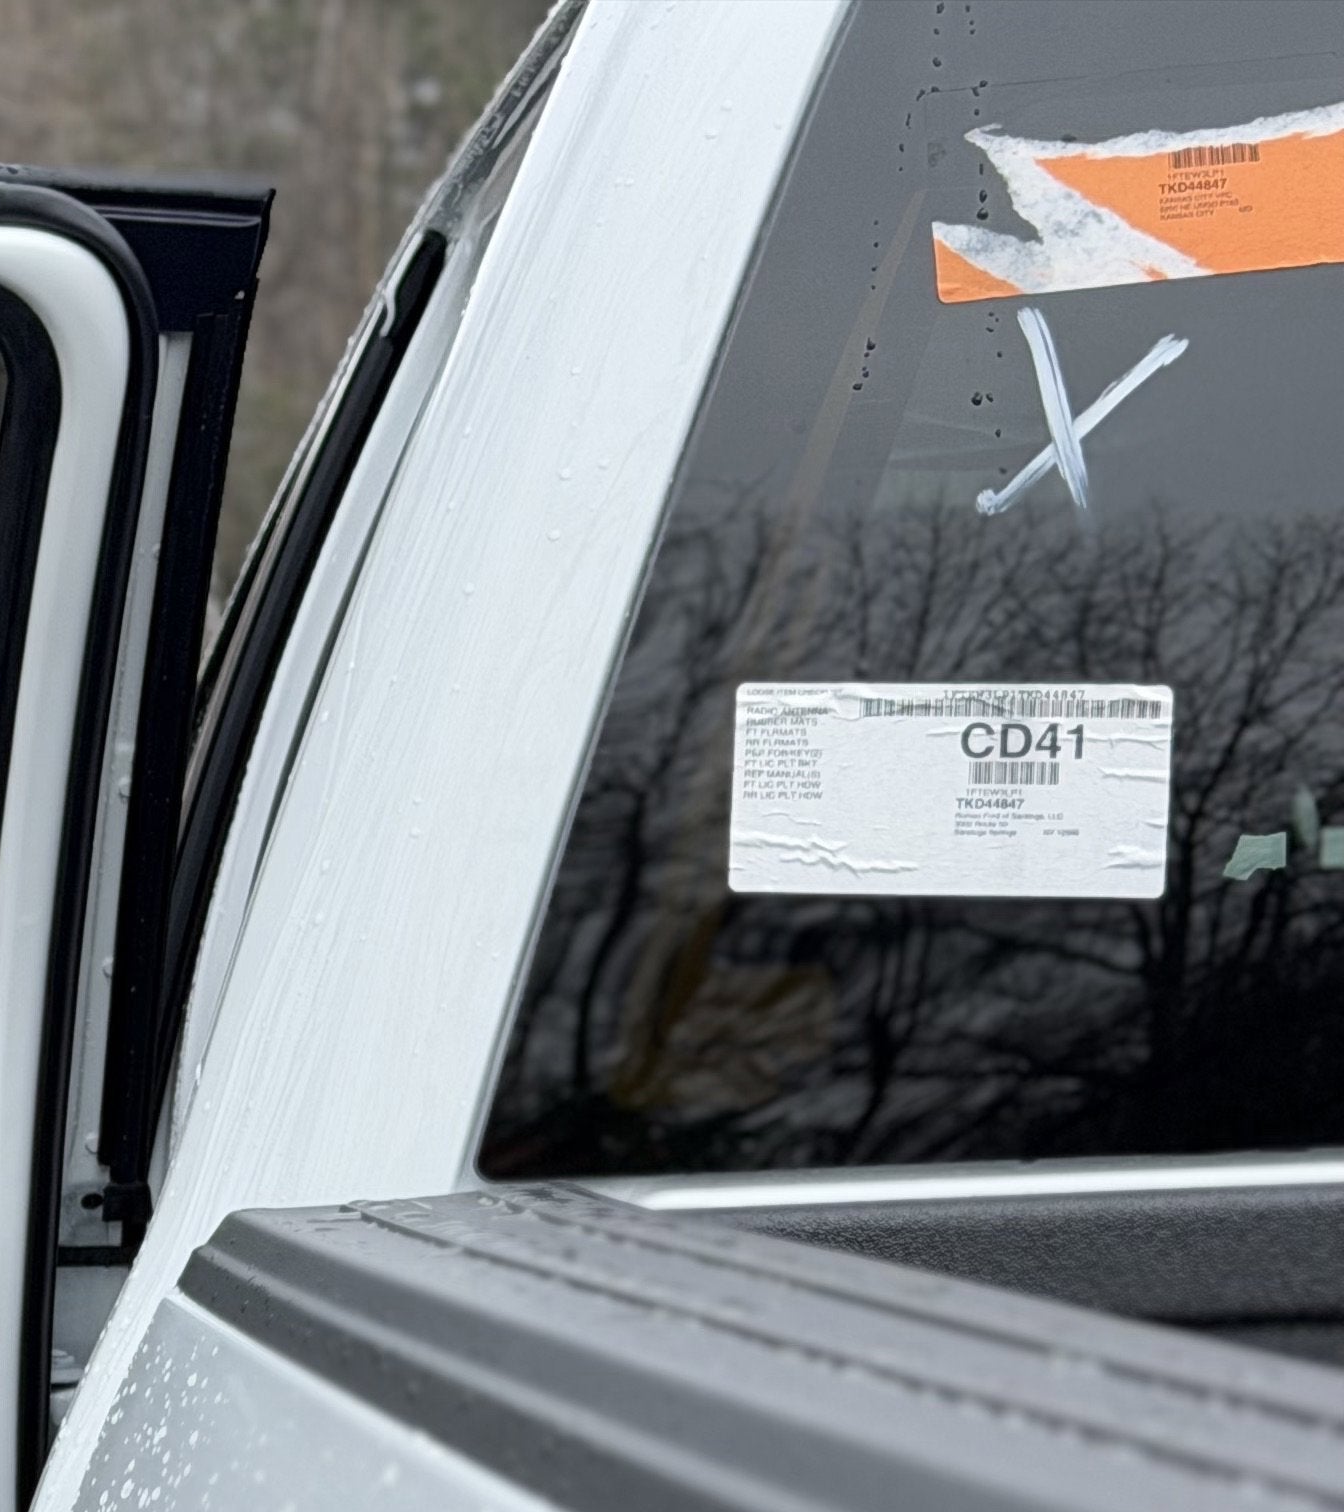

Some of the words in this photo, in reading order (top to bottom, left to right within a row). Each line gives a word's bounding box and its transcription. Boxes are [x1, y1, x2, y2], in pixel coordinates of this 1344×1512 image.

[1158, 178, 1227, 194] TKD44847
[746, 706, 778, 714] RADIO
[790, 717, 818, 726] MATS
[960, 722, 1085, 760] CD41
[955, 798, 1026, 810] TKD44847
